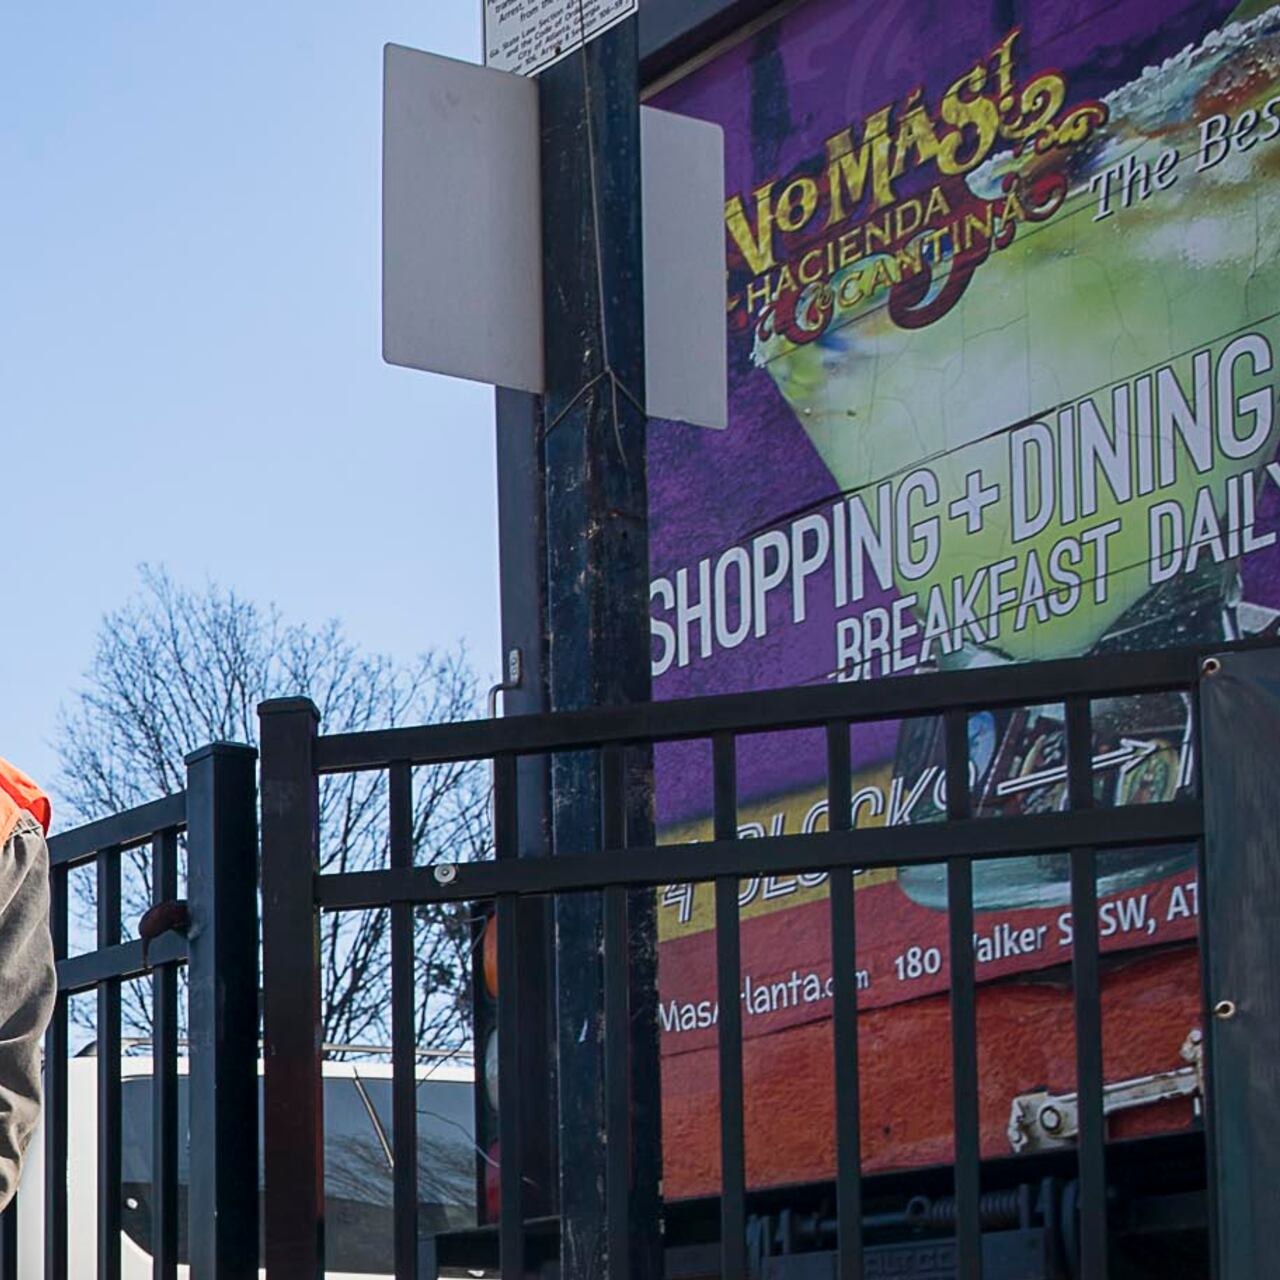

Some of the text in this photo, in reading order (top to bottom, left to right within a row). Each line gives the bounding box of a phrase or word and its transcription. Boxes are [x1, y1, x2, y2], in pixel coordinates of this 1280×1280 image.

[746, 185, 948, 312] HACIENDA
[1090, 147, 1180, 223] The
[650, 468, 941, 678] SHOPPING
[1011, 332, 1274, 543] DINING
[836, 462, 1280, 682] BREAKFAST DAIL
[894, 946, 941, 982] 180
[972, 922, 1047, 963] alker
